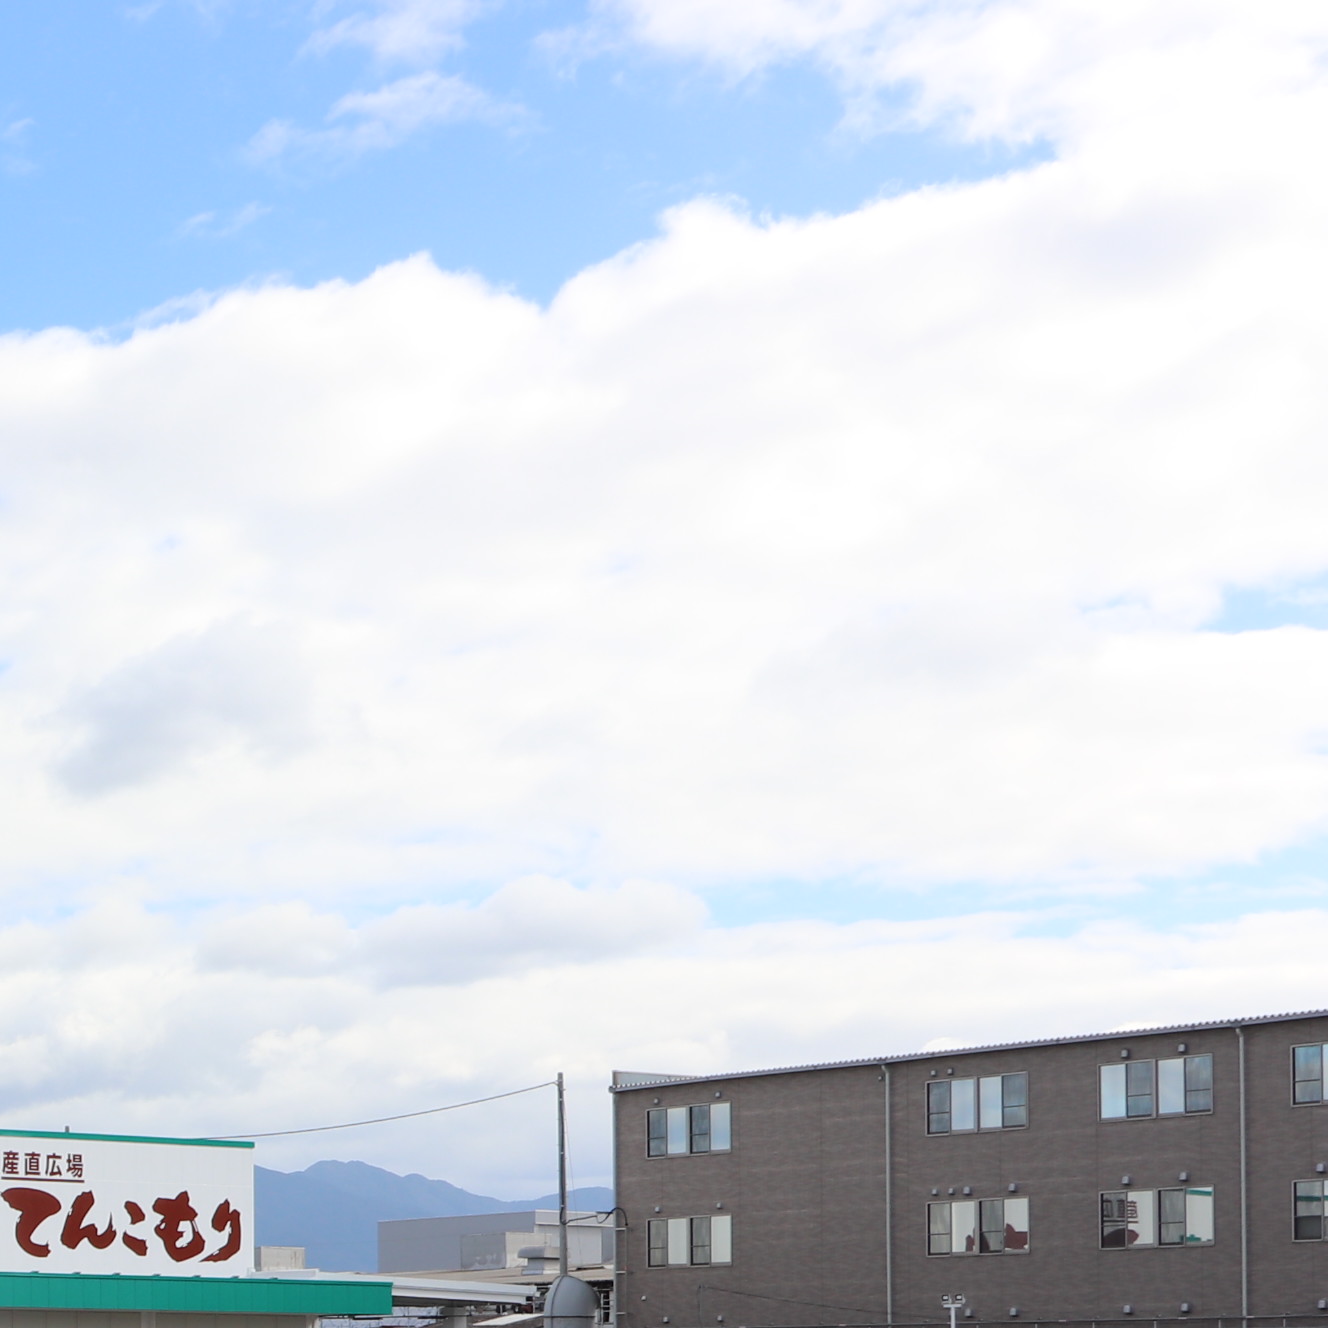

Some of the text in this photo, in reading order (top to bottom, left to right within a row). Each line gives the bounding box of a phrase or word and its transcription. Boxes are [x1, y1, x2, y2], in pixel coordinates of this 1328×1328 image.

[2, 1150, 84, 1178] 産直広場
[0, 1187, 242, 1263] てんこもり
